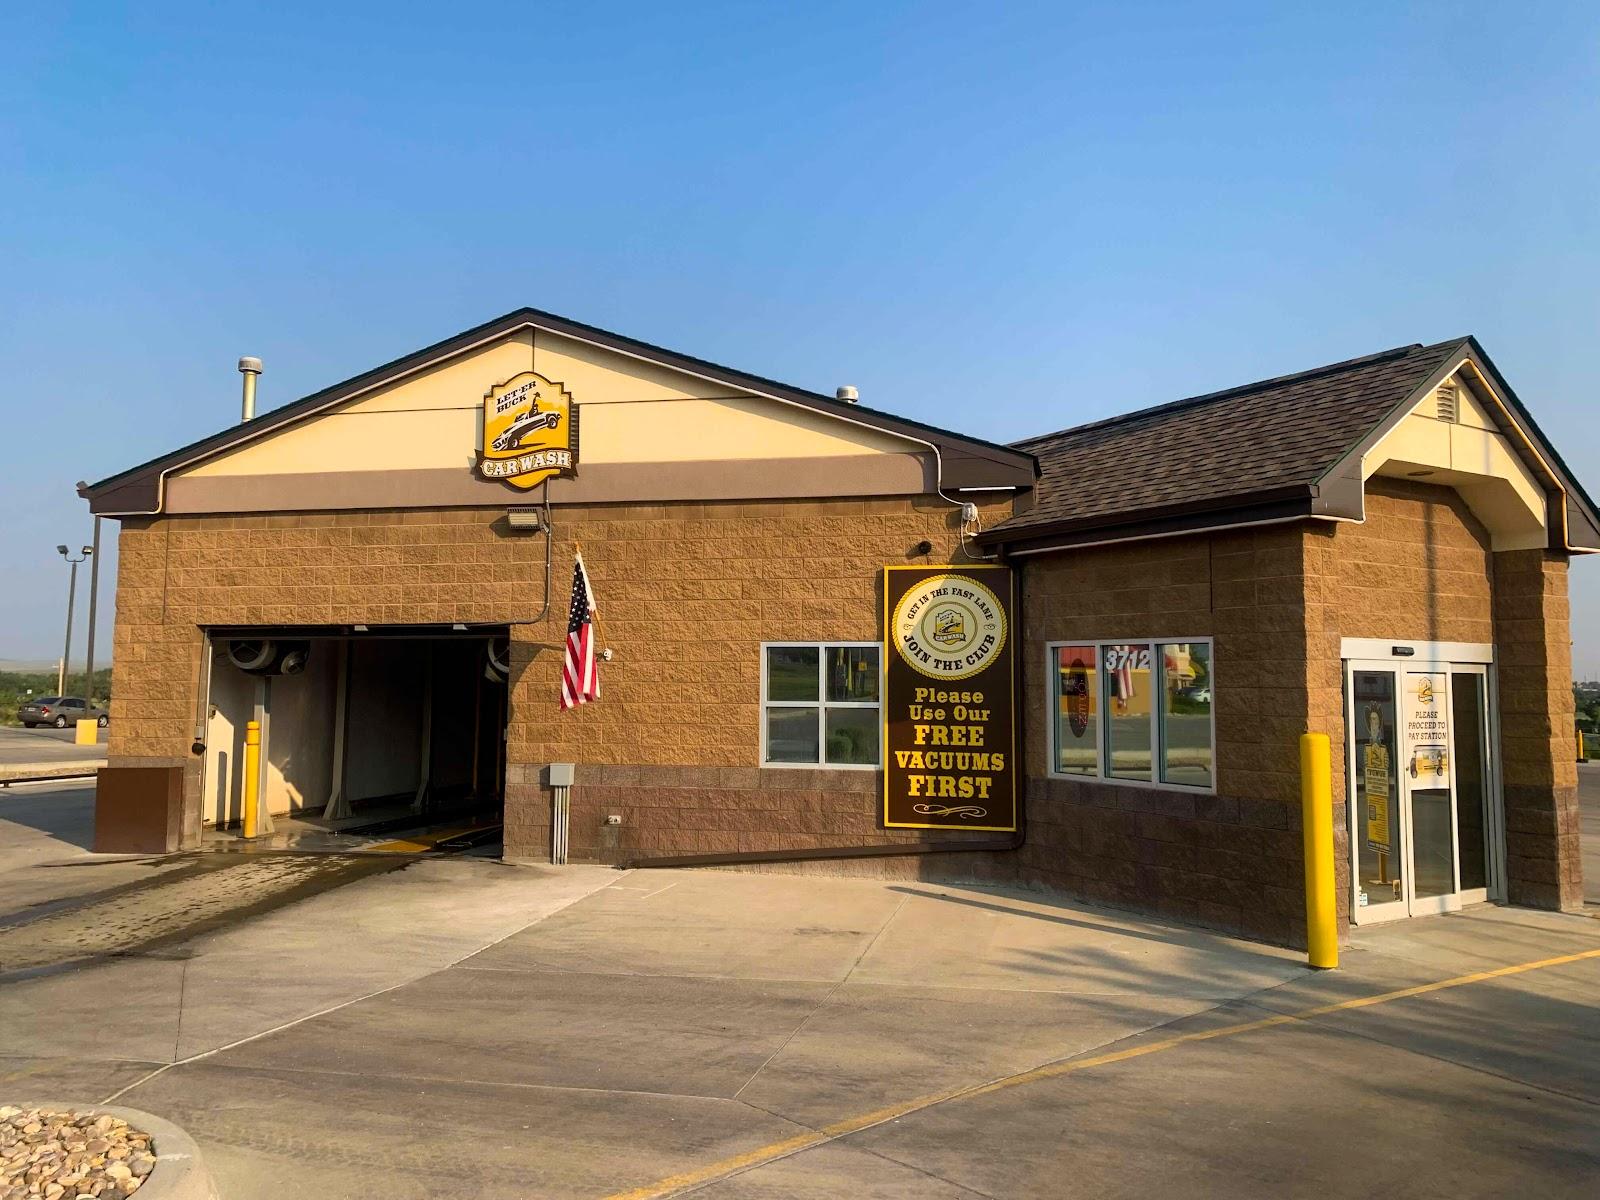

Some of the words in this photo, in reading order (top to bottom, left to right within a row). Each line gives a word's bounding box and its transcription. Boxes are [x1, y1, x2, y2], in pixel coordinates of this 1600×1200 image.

[496, 393, 527, 414] BUCK
[482, 460, 518, 475] CAR
[520, 451, 571, 471] WASH
[907, 602, 920, 620] GET
[918, 594, 929, 605] IN
[930, 587, 949, 600] THE
[951, 587, 975, 600] FAST
[974, 597, 994, 621] LANE
[903, 634, 932, 664] JOIN
[934, 658, 963, 671] THE
[965, 634, 995, 666] CLUB
[1106, 650, 1150, 670] 3712
[914, 687, 984, 703] Please
[909, 704, 946, 720] Use
[953, 705, 990, 721] Our
[1415, 711, 1438, 719] PLEASE
[914, 725, 984, 746] FREE
[1408, 721, 1437, 730] PROCEED
[1438, 721, 1445, 729] TO
[1408, 732, 1419, 740] PAY
[1420, 732, 1446, 740] STATION
[894, 751, 1005, 771] VACUUMS
[908, 775, 992, 799] FIRST
